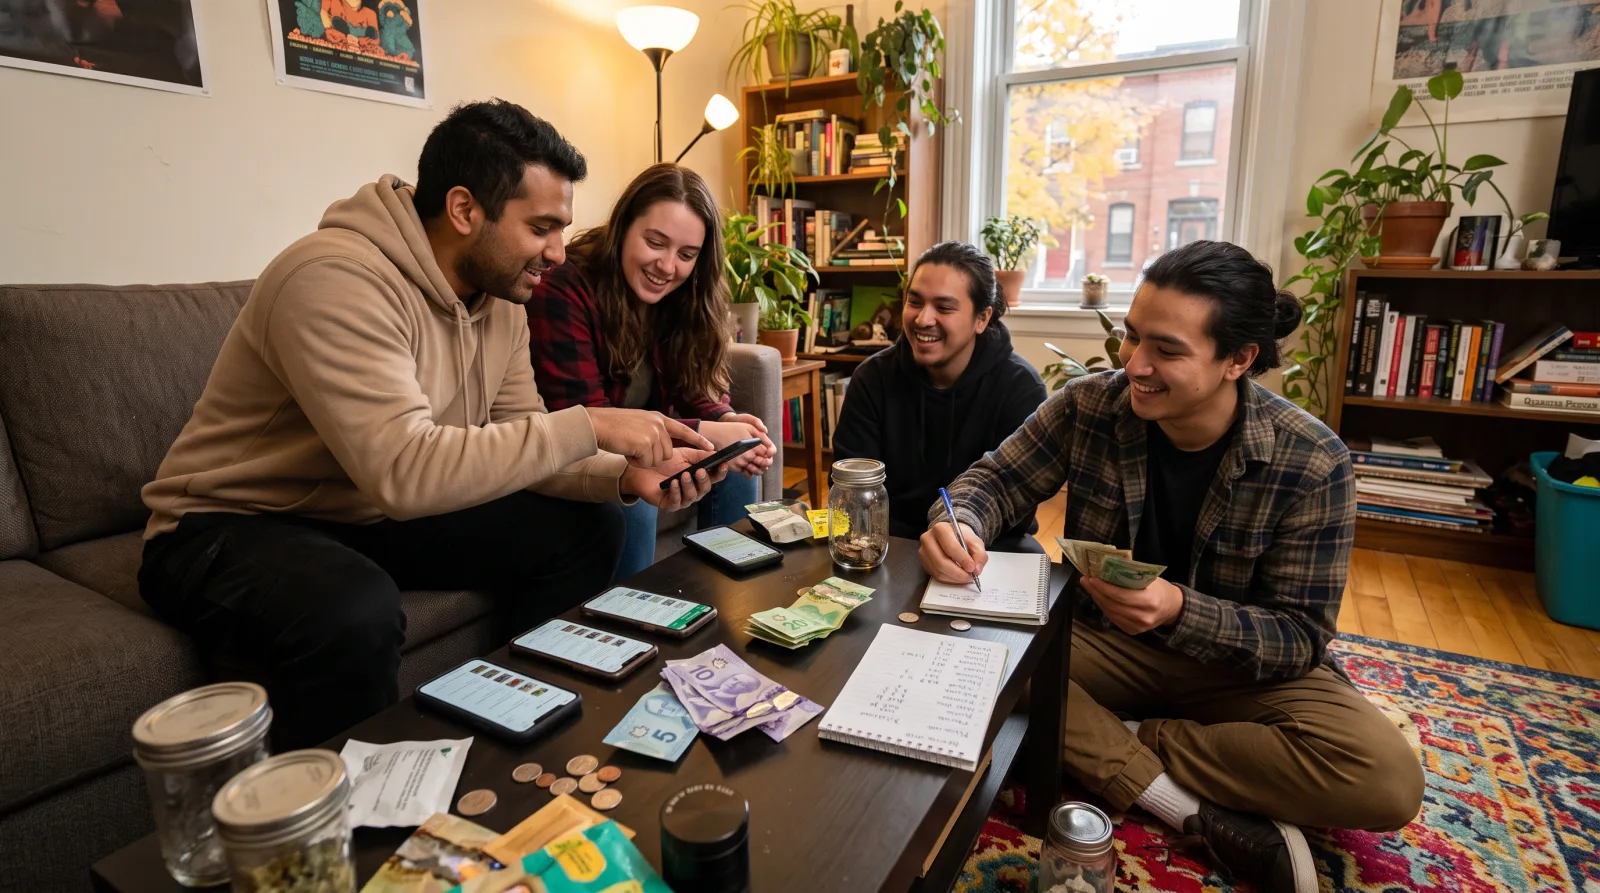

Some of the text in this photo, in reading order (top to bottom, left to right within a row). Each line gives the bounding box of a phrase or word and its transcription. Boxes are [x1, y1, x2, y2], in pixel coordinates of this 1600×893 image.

[783, 619, 808, 631] 20
[688, 664, 715, 681] 10
[651, 728, 677, 743] 5
